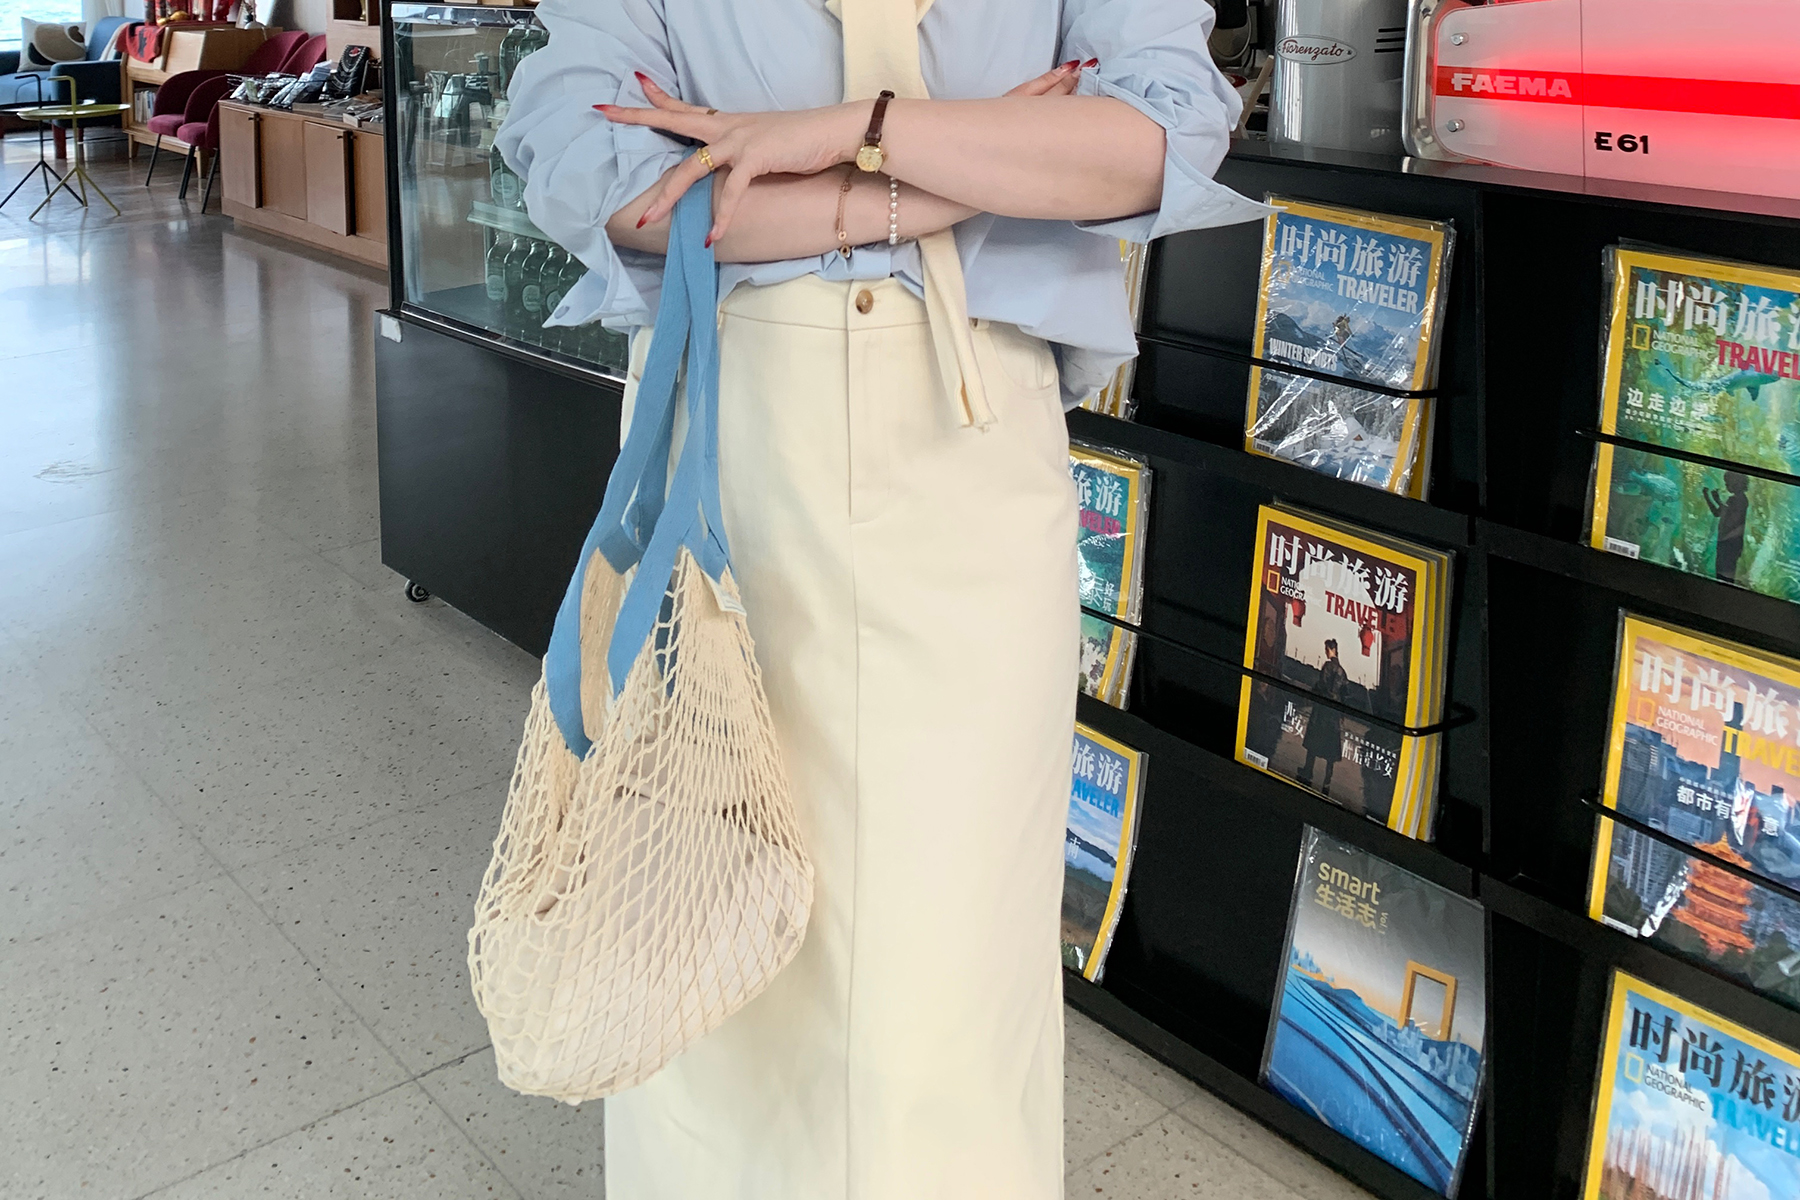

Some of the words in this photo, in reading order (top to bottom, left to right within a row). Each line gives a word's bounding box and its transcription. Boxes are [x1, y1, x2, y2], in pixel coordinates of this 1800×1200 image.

[1281, 39, 1344, 61] Fiorenzato
[1451, 72, 1572, 98] FAEMA
[1280, 223, 1424, 288] 时尚旅游
[1337, 274, 1418, 314] TRAVELER
[1269, 337, 1302, 362] WINTER
[1653, 329, 1699, 347] NATIONAL
[1269, 532, 1409, 614] 时尚旅游
[1640, 652, 1800, 747] 时尚旅
[1656, 717, 1718, 746] GEOGRAPHIC
[1658, 705, 1705, 730] NATIONAL
[1318, 862, 1381, 906] smart
[1314, 883, 1377, 930] 生活志
[1644, 1077, 1706, 1112] GEOGRAPHIC
[1646, 1063, 1693, 1094] NATIONAL
